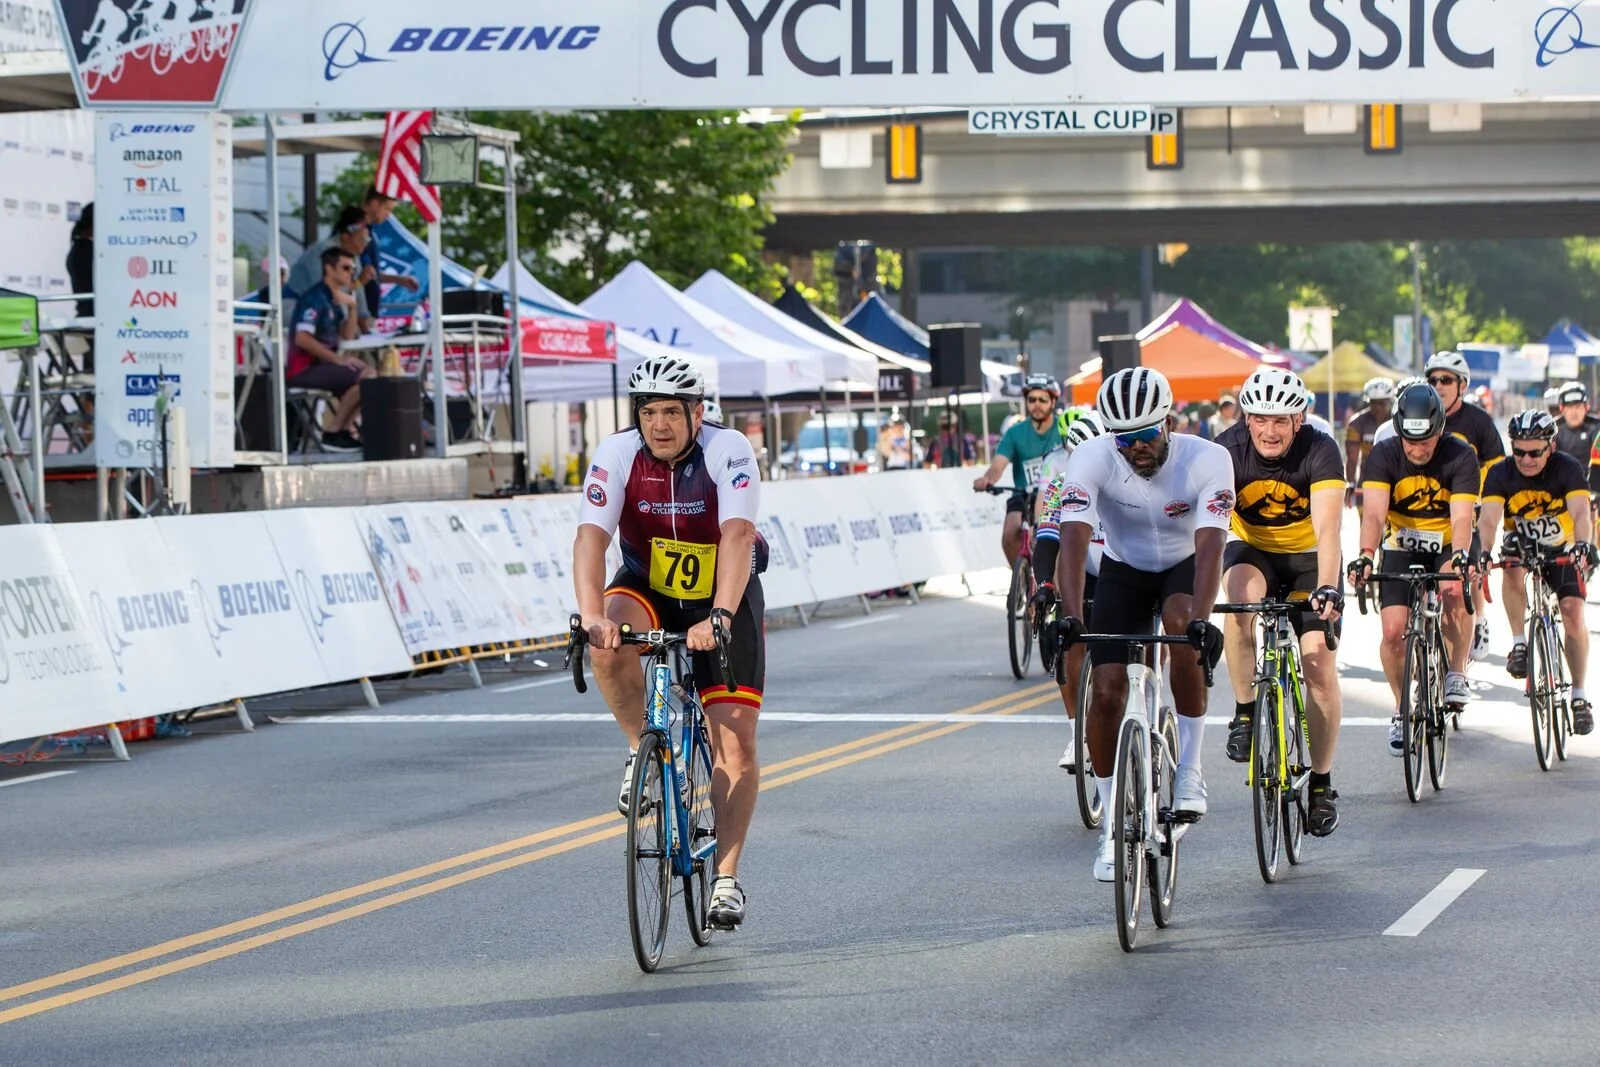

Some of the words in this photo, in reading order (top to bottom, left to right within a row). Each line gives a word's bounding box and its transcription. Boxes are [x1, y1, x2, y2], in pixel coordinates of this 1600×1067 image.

[388, 26, 600, 52] BOEING
[657, 0, 1072, 78] CYCLING
[1102, 0, 1495, 73] CLASSIC
[972, 110, 1086, 131] CRYSTAL
[1094, 110, 1148, 129] CUP
[131, 124, 196, 134] BOEING
[123, 149, 182, 161] amazon
[123, 177, 182, 192] TOTAL
[108, 235, 189, 246] BLUEHALO
[150, 259, 177, 275] JLL
[130, 287, 177, 308] AON
[116, 328, 189, 341] NTConcepts
[647, 381, 657, 391] 79
[1260, 402, 1275, 410] 1751
[652, 507, 680, 515] CYCLING
[681, 505, 707, 515] CLASSIC
[684, 500, 705, 508] FORCES
[1517, 516, 1561, 539] 1625
[666, 545, 689, 554] CYCLING
[664, 550, 701, 591] 79
[321, 571, 380, 605] BOEING
[217, 579, 292, 618] BOEING
[117, 589, 190, 633] BOEING
